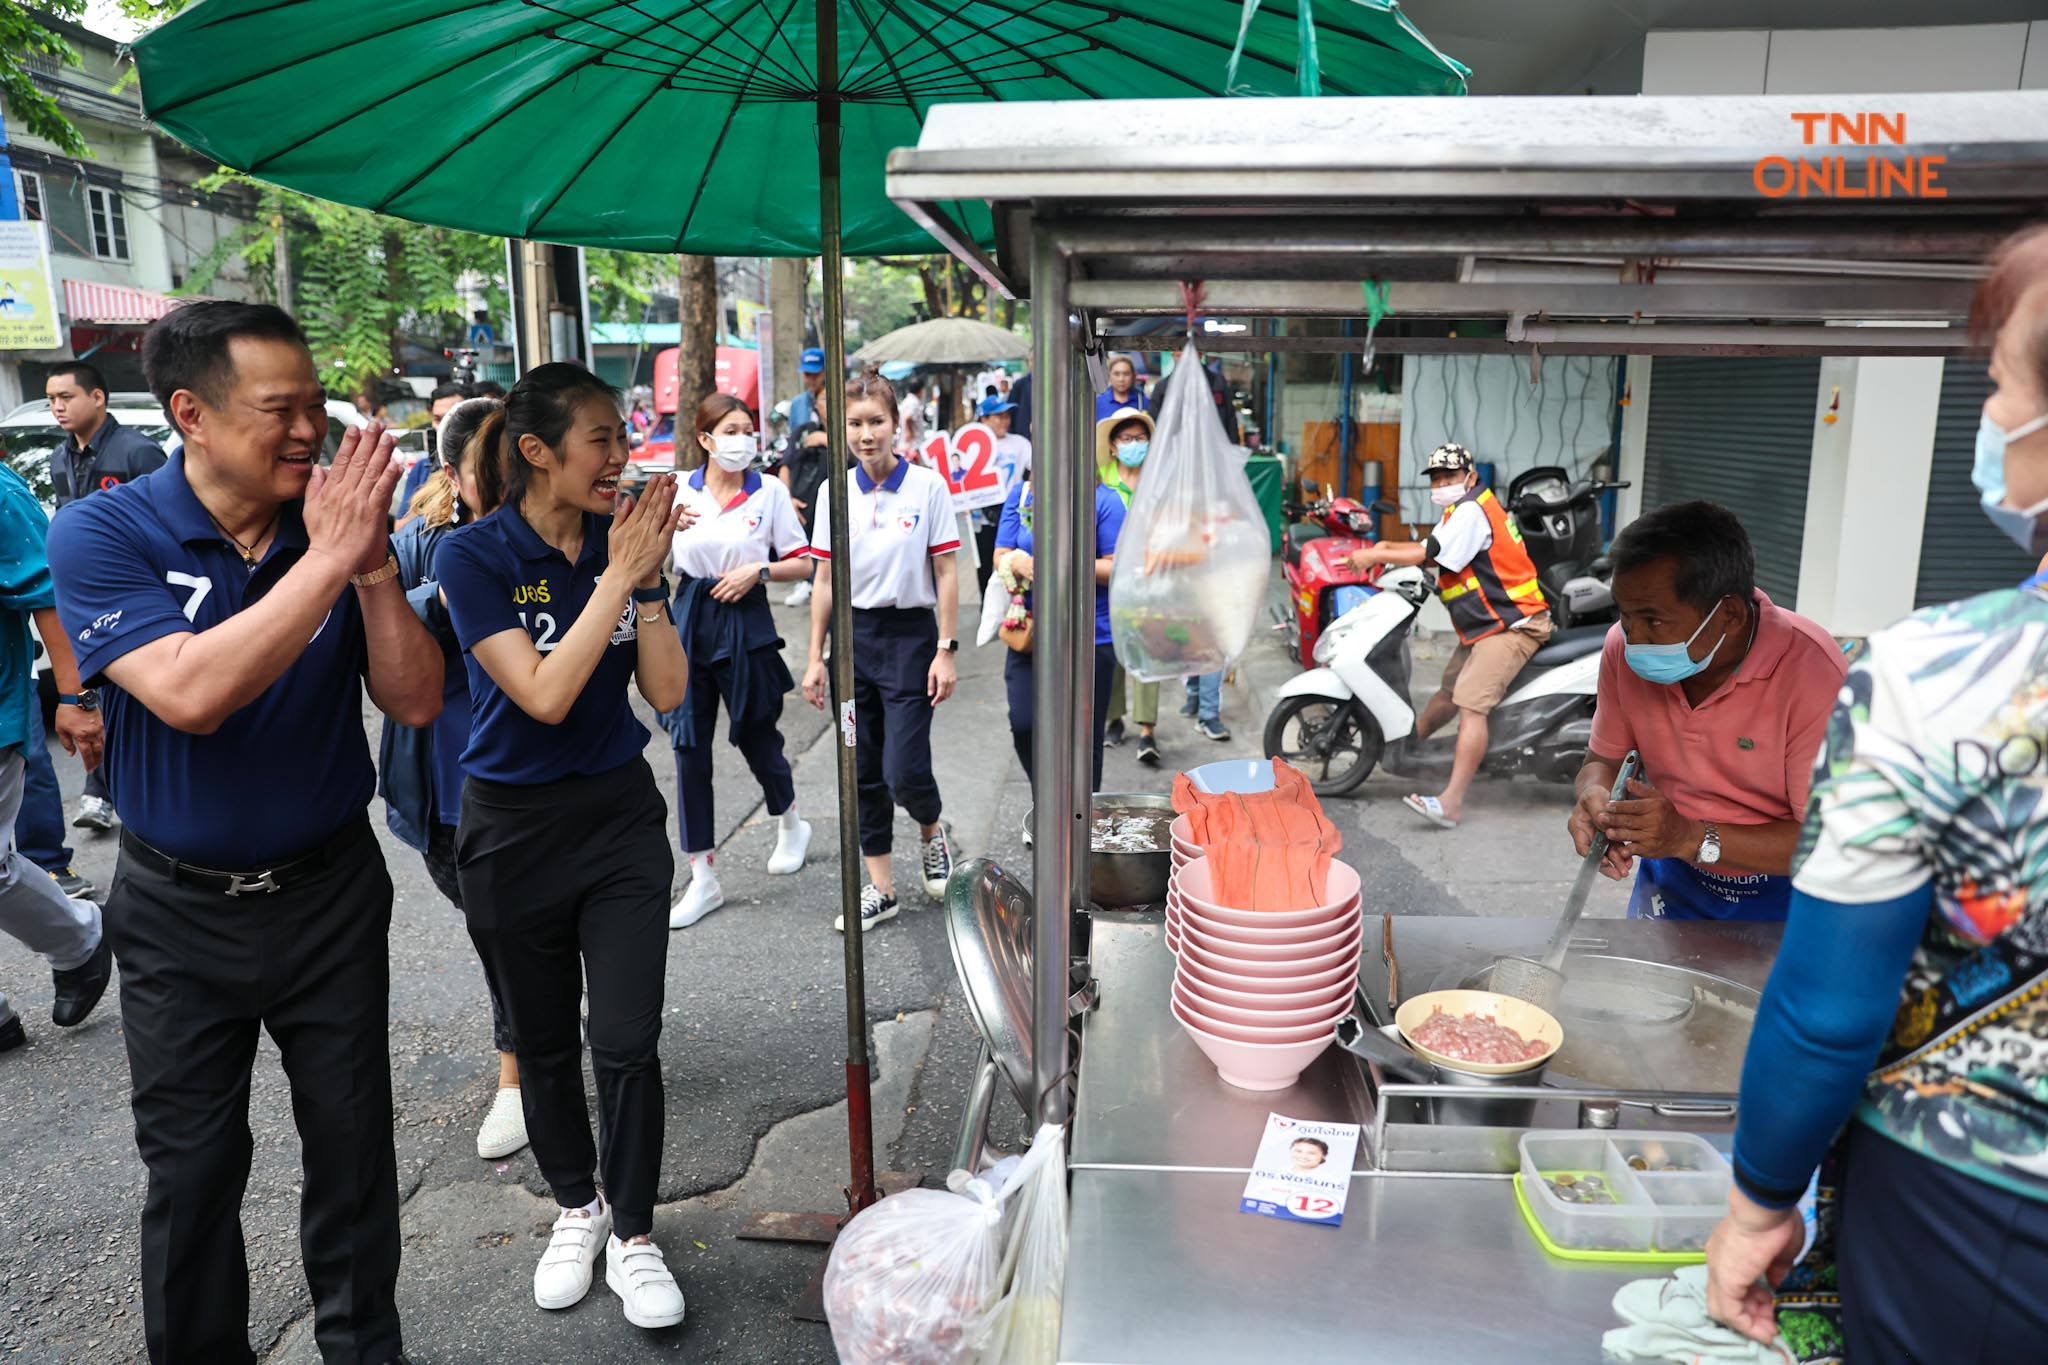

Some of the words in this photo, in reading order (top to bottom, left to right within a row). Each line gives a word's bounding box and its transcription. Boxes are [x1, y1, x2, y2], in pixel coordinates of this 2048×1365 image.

[926, 429, 998, 496] 12
[166, 570, 213, 624] 7
[1294, 1195, 1334, 1214] 12
